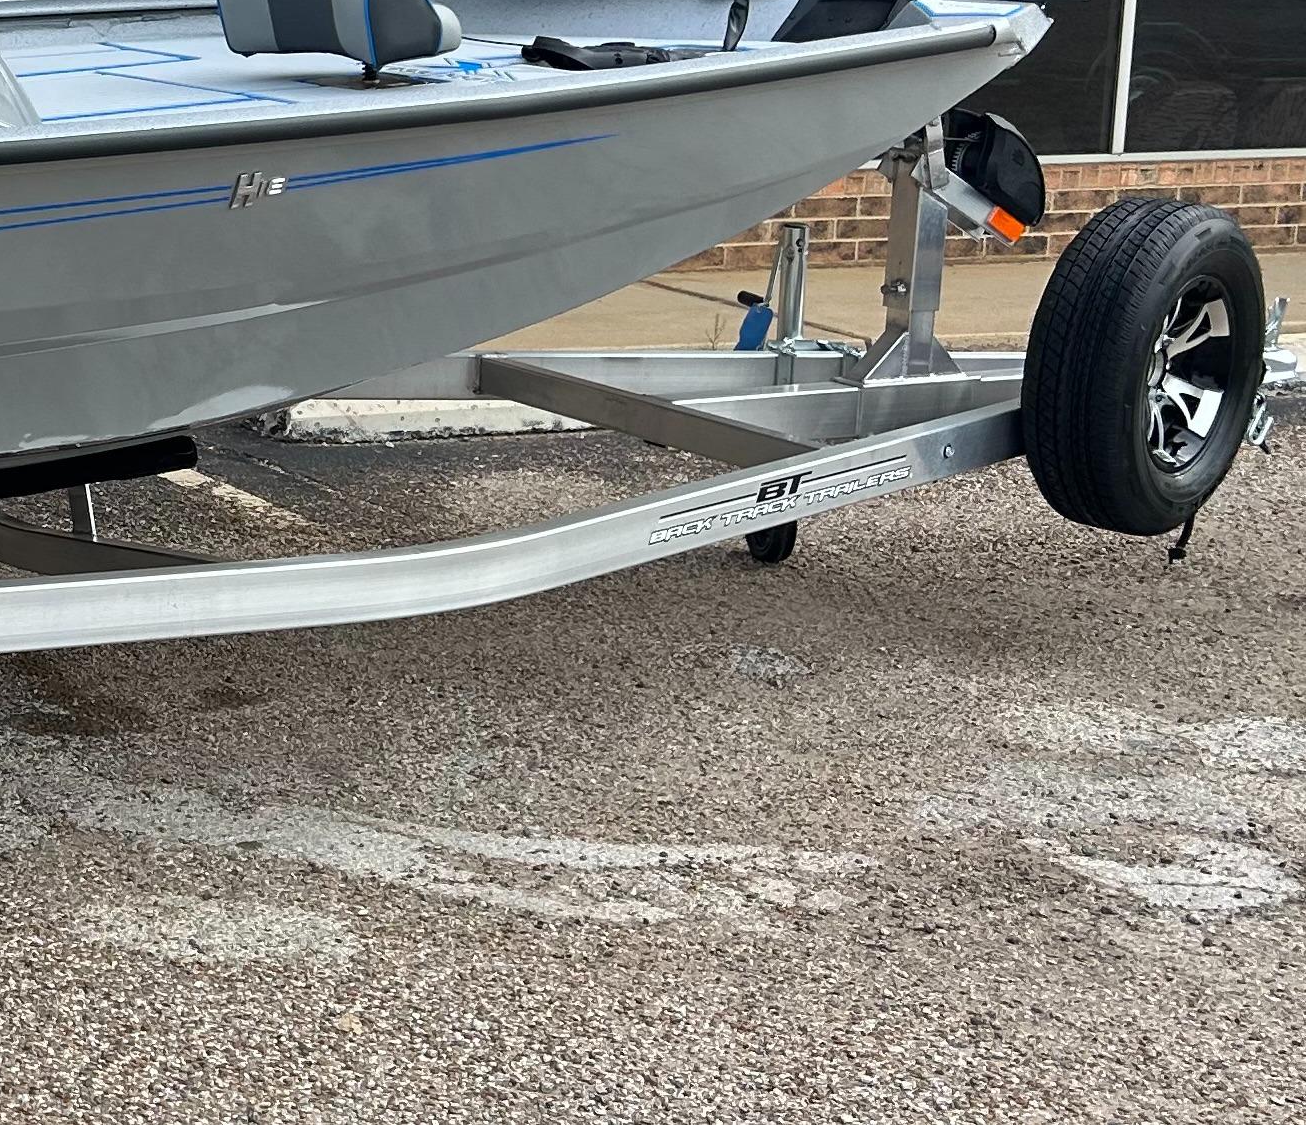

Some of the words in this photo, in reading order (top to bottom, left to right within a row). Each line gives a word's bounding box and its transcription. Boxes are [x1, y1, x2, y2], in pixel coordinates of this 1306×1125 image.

[648, 515, 717, 545] BACK
[720, 495, 800, 526] TRACK
[803, 466, 913, 505] TRAILERS
[756, 471, 813, 503] BT
